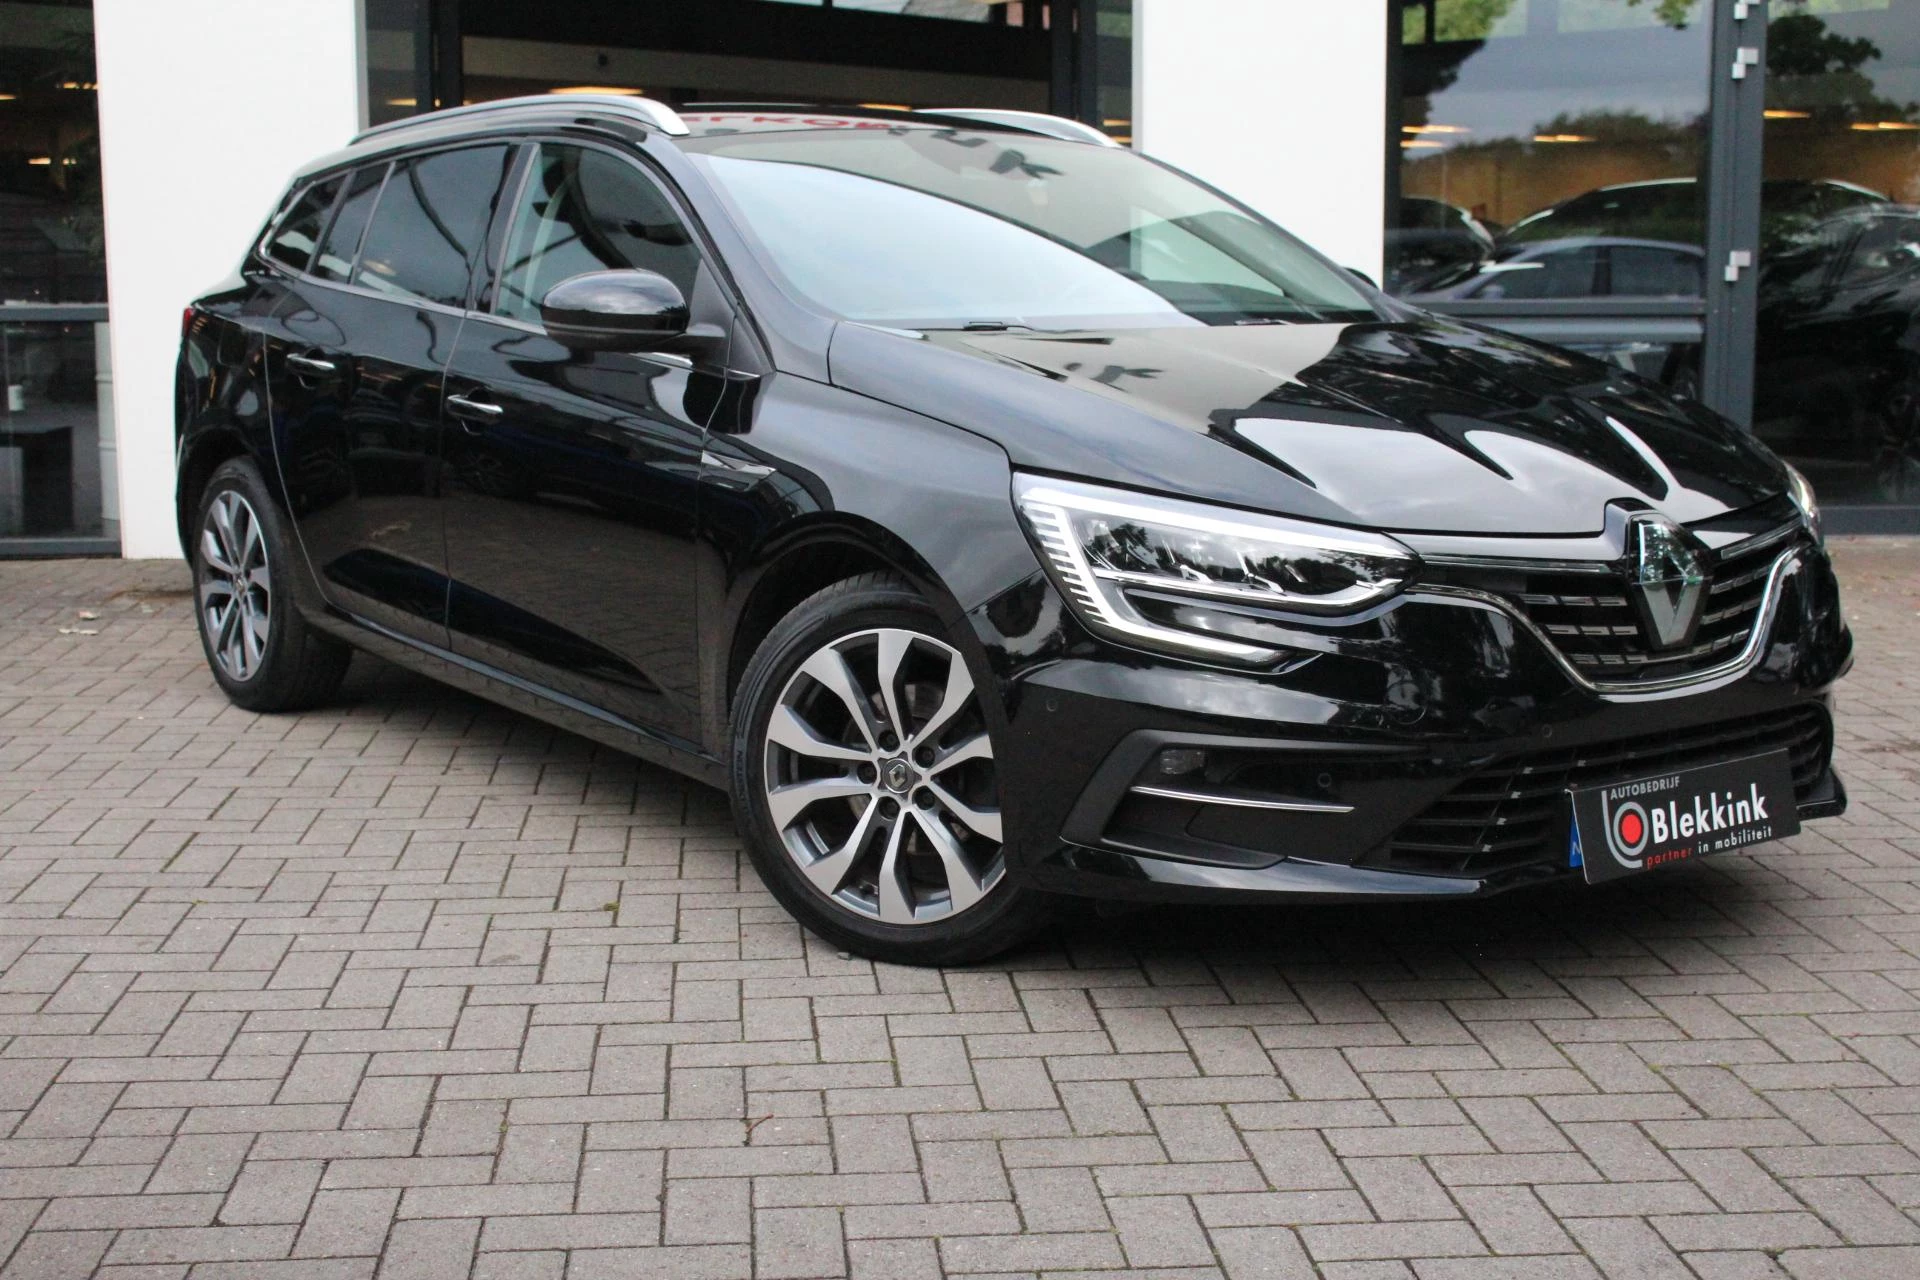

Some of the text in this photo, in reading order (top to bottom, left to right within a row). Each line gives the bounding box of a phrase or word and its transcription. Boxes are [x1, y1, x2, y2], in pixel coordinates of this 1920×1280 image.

[1610, 776, 1681, 801] AUTOBEDRIJF
[1651, 783, 1769, 844] Blekkink
[1646, 825, 1772, 870] partner in mobiliteit
